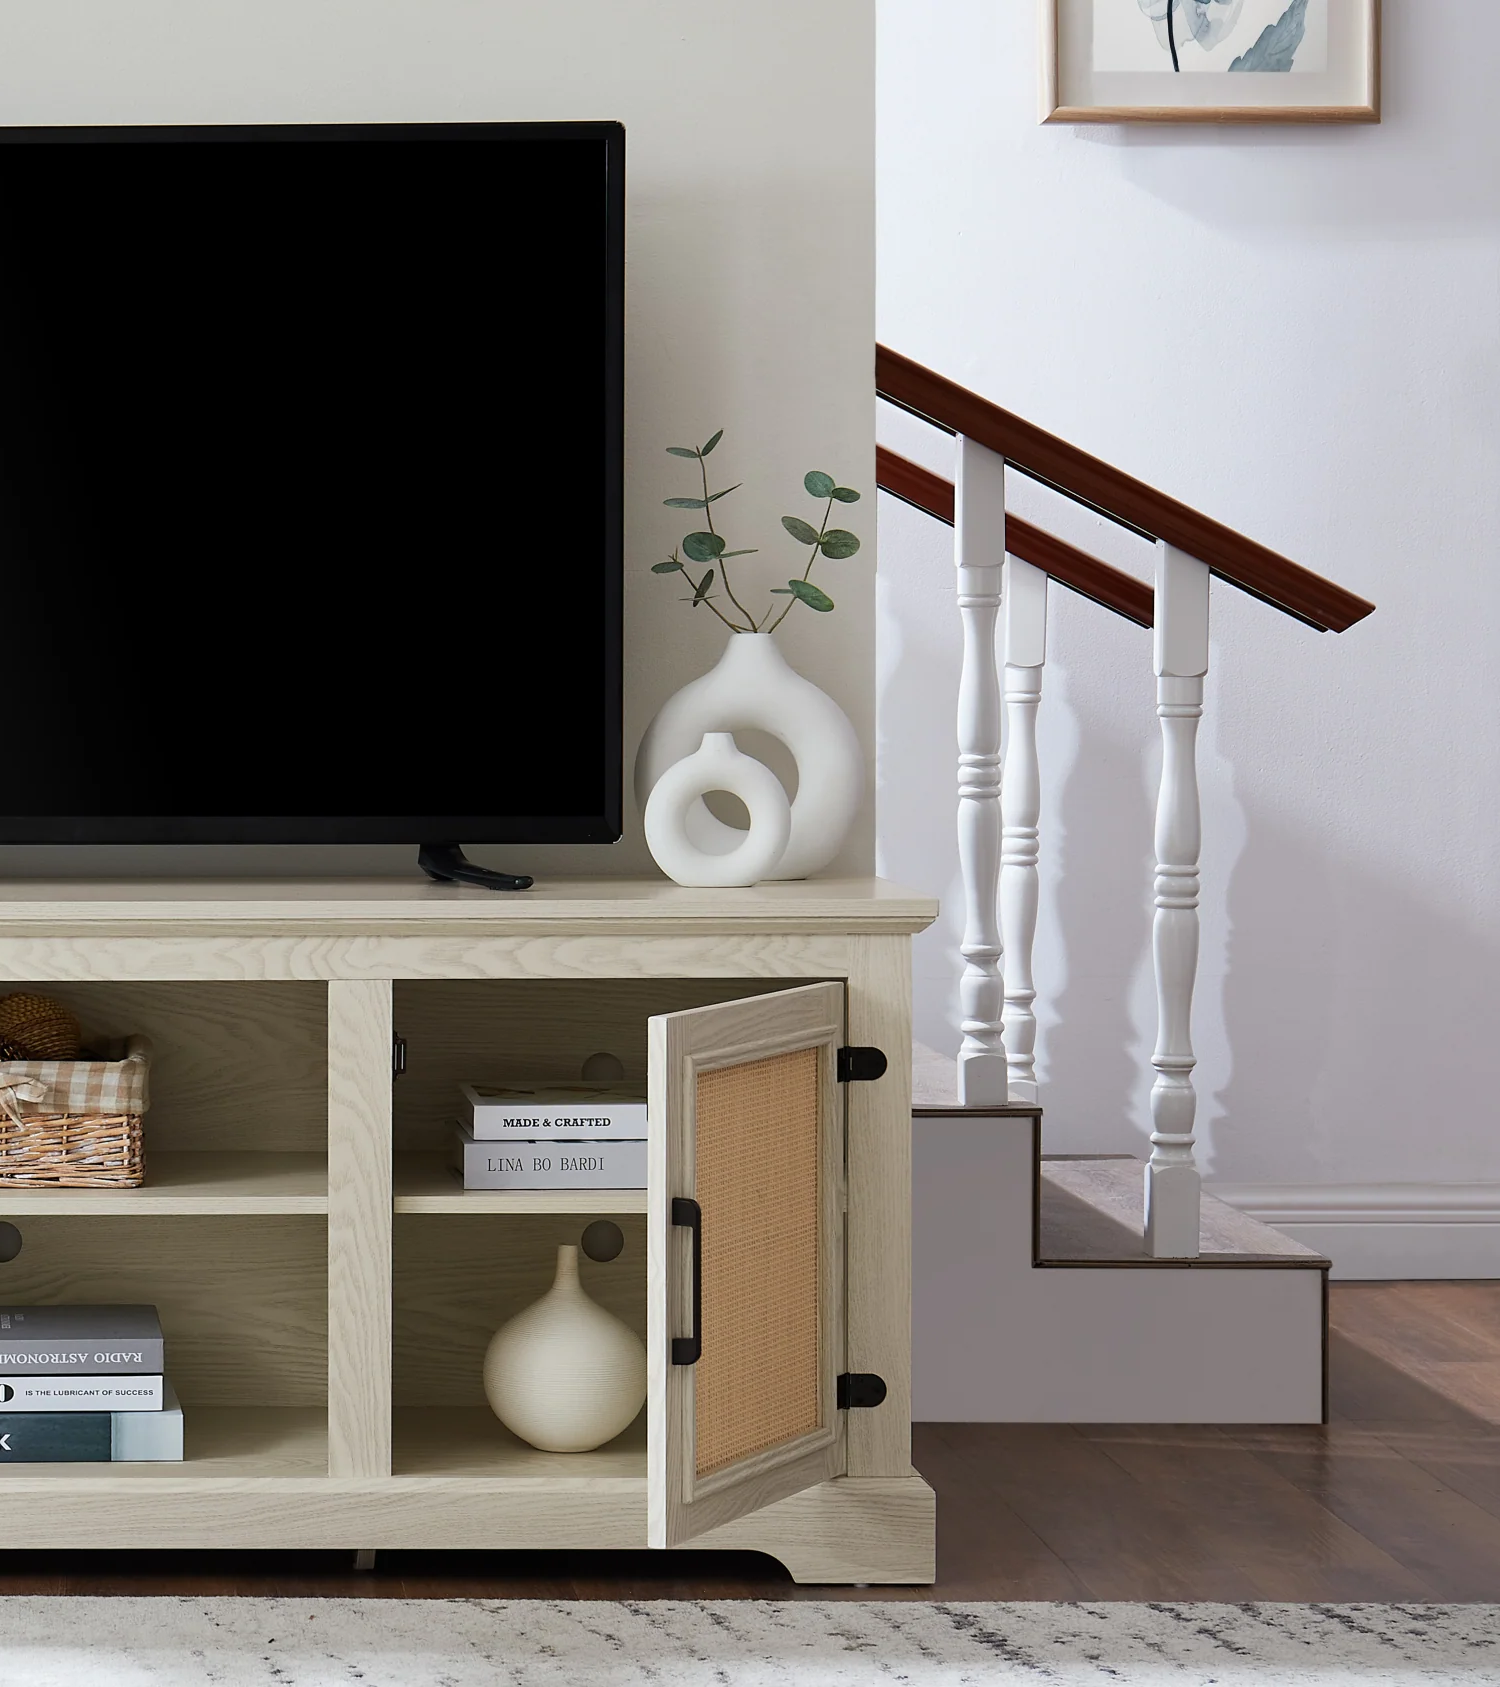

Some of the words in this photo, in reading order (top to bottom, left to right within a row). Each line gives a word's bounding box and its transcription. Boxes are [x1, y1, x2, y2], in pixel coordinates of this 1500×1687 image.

[502, 1118, 540, 1128] MADE
[542, 1118, 552, 1127] &
[554, 1117, 611, 1127] CRAFTED
[487, 1158, 524, 1172] LINA
[533, 1157, 552, 1172] BO
[560, 1157, 605, 1171] BARDI
[94, 1352, 143, 1363] RADIO
[35, 1389, 51, 1397] THE
[53, 1389, 100, 1397] LUBRICANT
